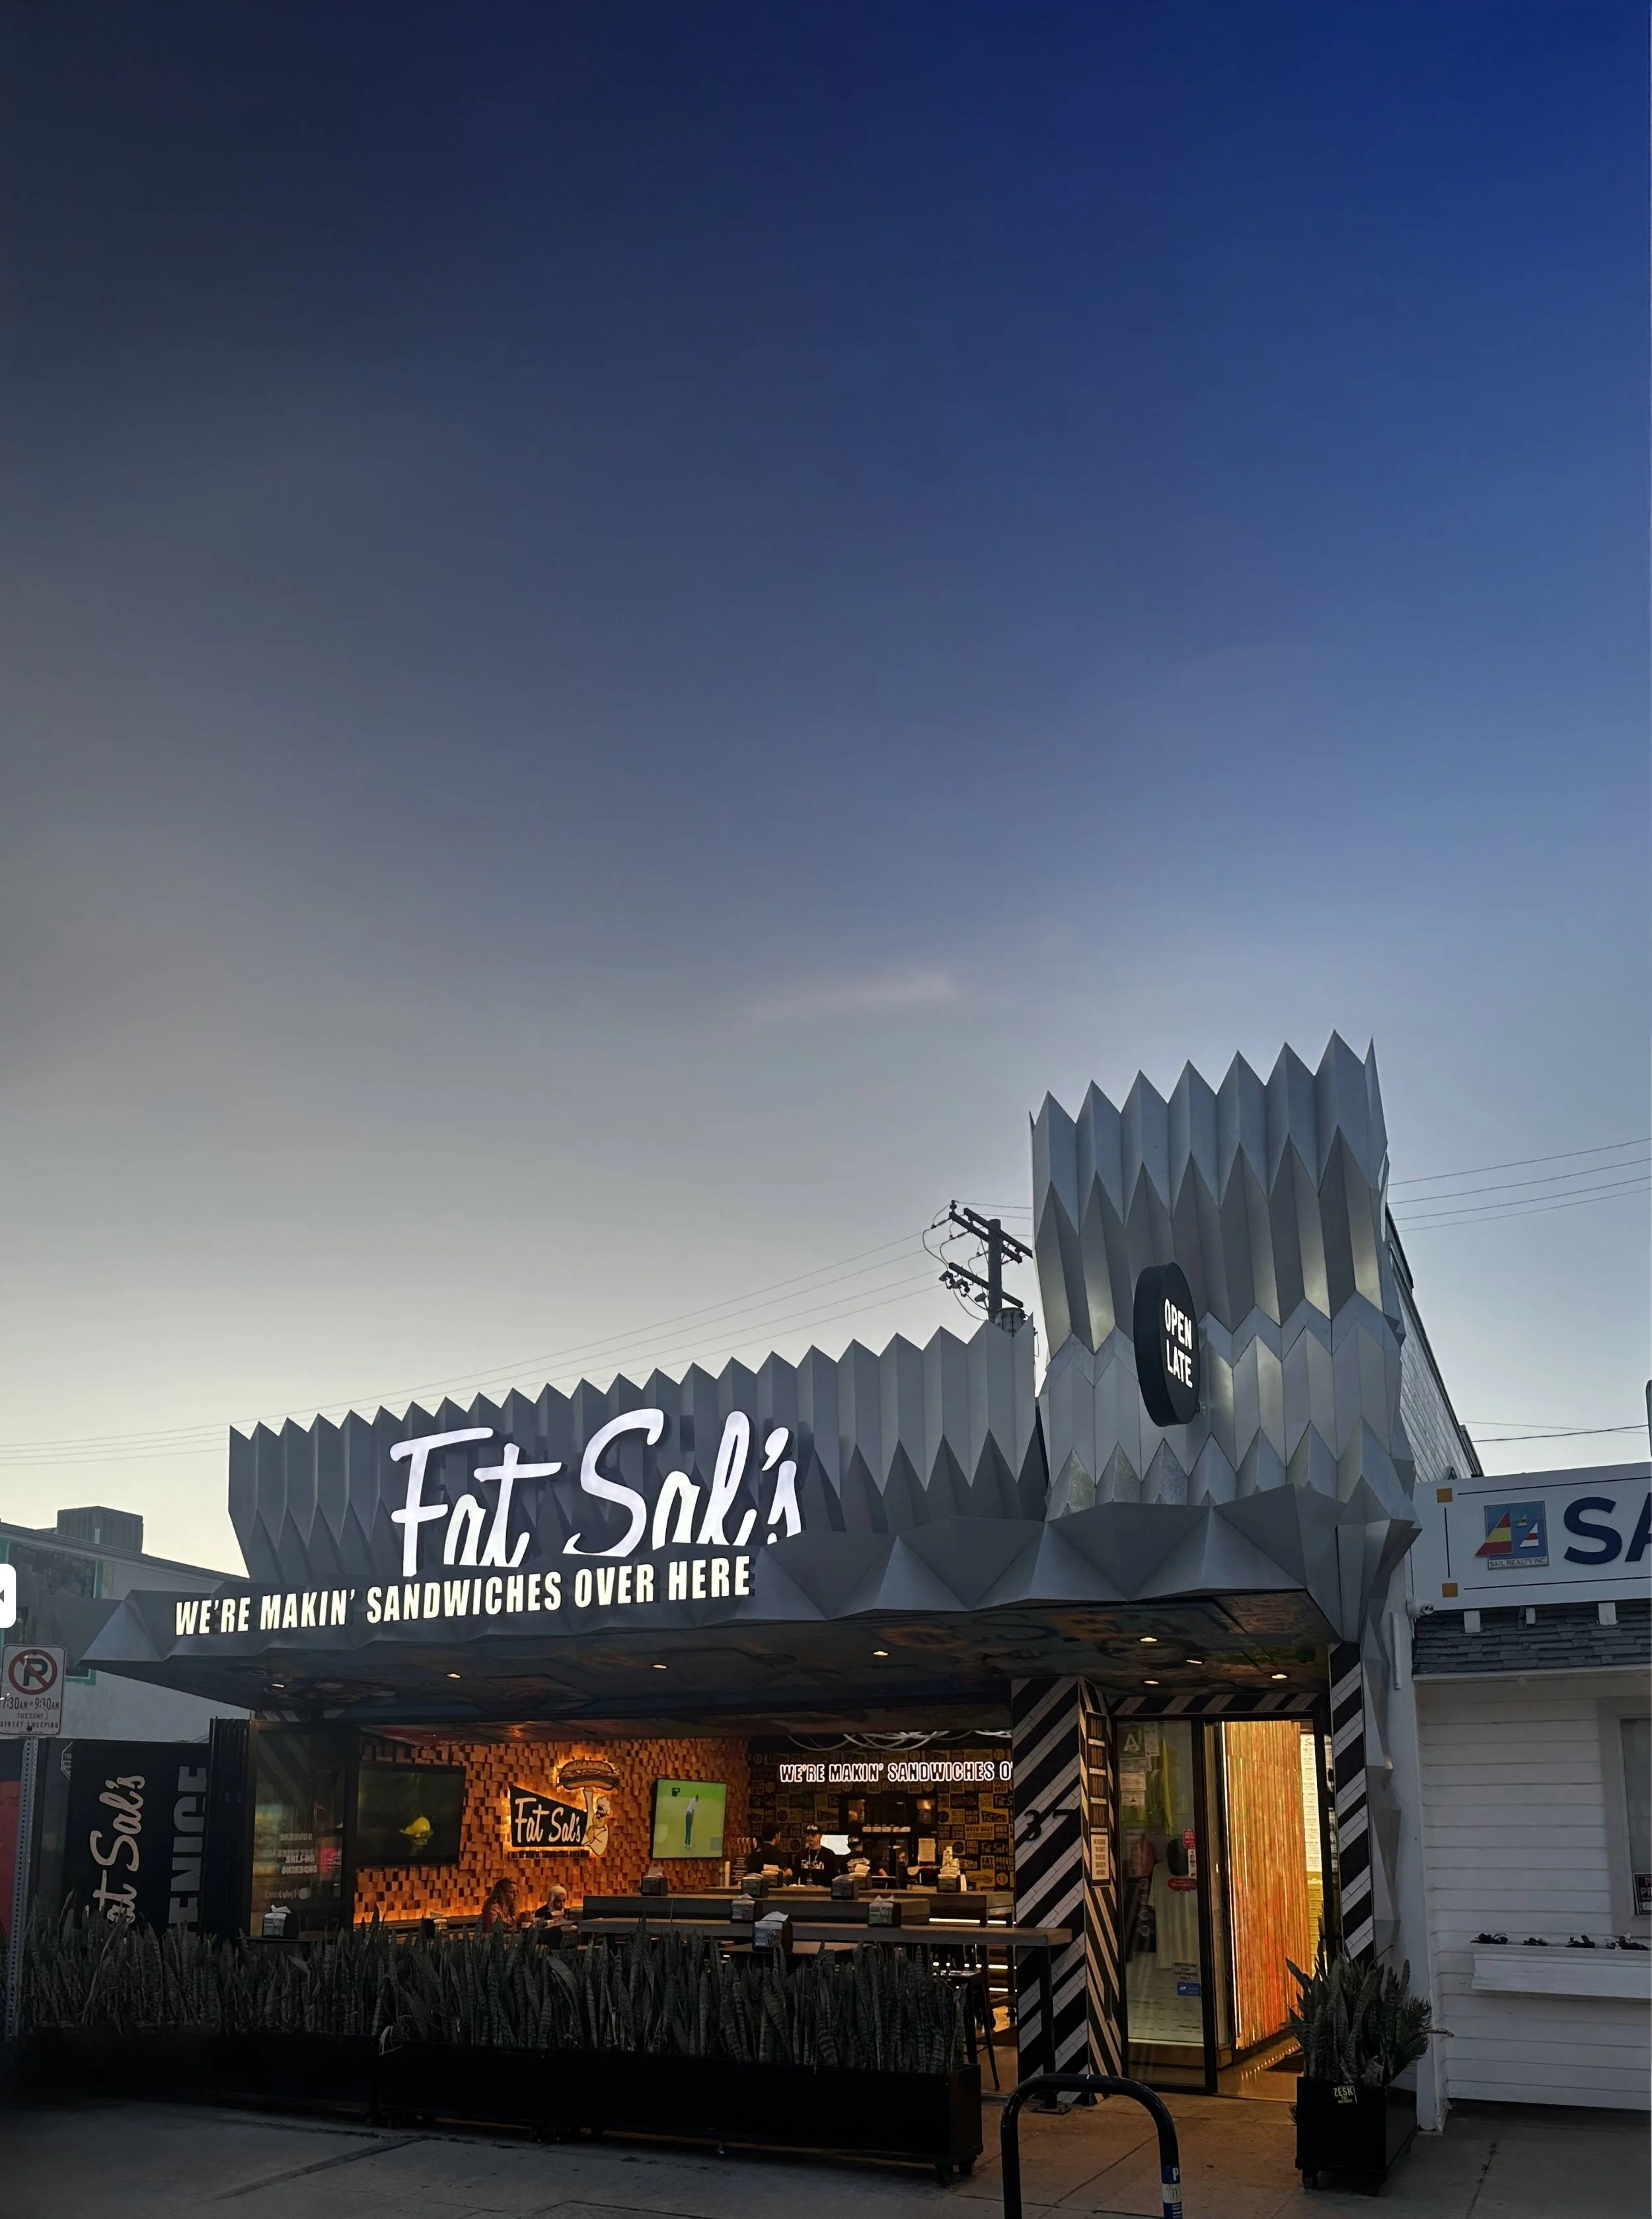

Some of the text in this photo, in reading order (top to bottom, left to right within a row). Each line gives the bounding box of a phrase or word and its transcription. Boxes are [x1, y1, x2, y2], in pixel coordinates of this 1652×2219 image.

[1164, 1298, 1193, 1350] OPEN
[1166, 1339, 1193, 1388] LATE
[390, 1408, 802, 1578] Fat Sal's
[175, 1556, 750, 1636] WE'RE MAKIN' SANDWICHES OVER HERE
[779, 1760, 1013, 1783] WE'RE MAKIN' SANDWICHES O
[85, 1775, 145, 1924] at Sal's
[168, 1766, 207, 1924] ENICE
[514, 1797, 581, 1843] Fat Sal's
